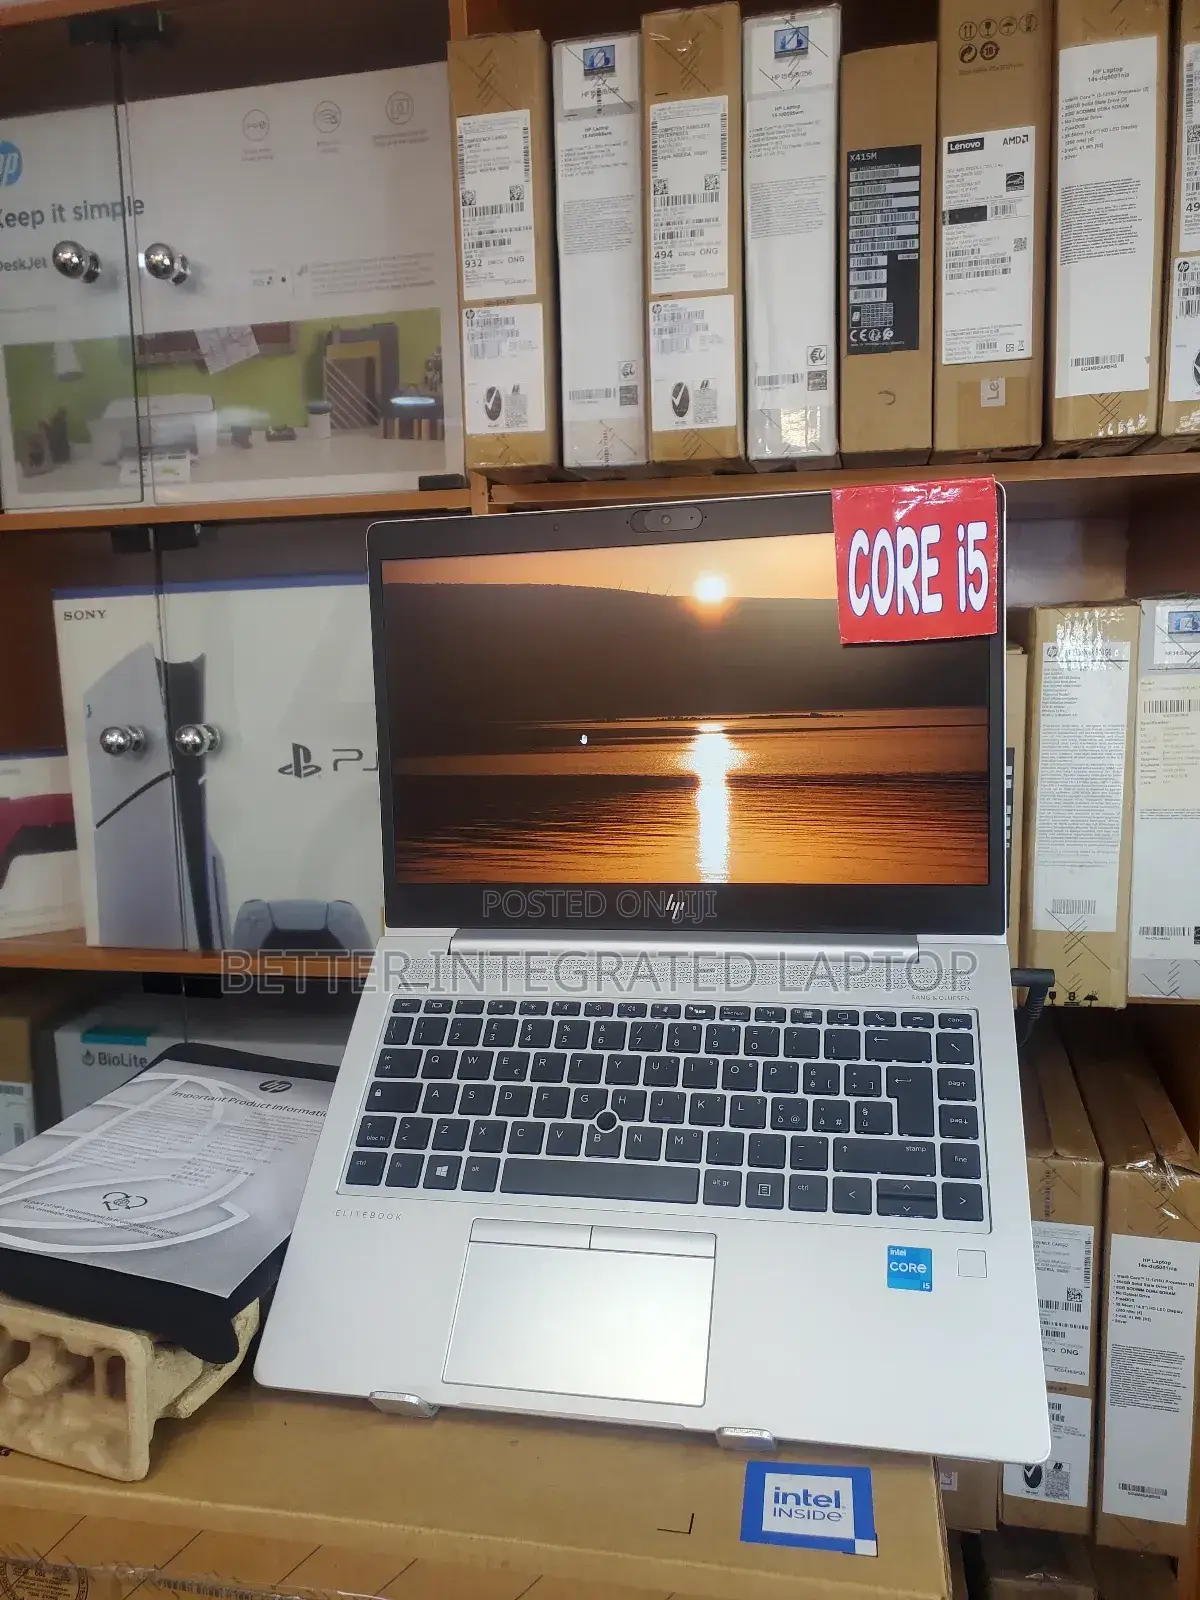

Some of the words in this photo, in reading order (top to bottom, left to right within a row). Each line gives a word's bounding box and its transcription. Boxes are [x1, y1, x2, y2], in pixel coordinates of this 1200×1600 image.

[950, 141, 981, 151] Lenovo
[1002, 135, 1022, 146] AMD
[850, 152, 877, 162] X415M
[51, 203, 67, 223] it
[72, 196, 145, 222] simple
[655, 249, 674, 260] 494
[700, 247, 719, 256] ONG
[465, 258, 483, 268] 932
[508, 255, 525, 264] ONG
[848, 527, 944, 617] CORE
[956, 520, 990, 613] i5
[63, 610, 107, 621] SONY
[674, 1039, 680, 1047] 8
[712, 1040, 719, 1048] 9
[97, 1051, 148, 1068] BioLite
[431, 1055, 440, 1064] Q
[467, 1056, 479, 1064] W
[502, 1057, 510, 1065] E
[538, 1058, 547, 1067] R
[576, 1059, 583, 1067] T
[614, 1060, 622, 1069] Y
[652, 1061, 660, 1070] U
[770, 1067, 778, 1076] P
[431, 1089, 440, 1098] A
[468, 1090, 475, 1099] S
[504, 1091, 513, 1100] D
[542, 1093, 549, 1101] F
[172, 1090, 226, 1102] Important
[227, 1097, 274, 1110] Product
[580, 1094, 589, 1103] G
[618, 1095, 627, 1105] H
[657, 1097, 664, 1106] J
[697, 1100, 705, 1109] K
[737, 1102, 745, 1111] L
[440, 1125, 449, 1134] Z
[478, 1126, 487, 1136] X
[516, 1128, 525, 1137] C
[556, 1130, 564, 1139] V
[593, 1133, 602, 1143] B
[633, 1133, 643, 1143] N
[674, 1136, 684, 1145] M
[954, 1155, 967, 1163] fine
[335, 1208, 403, 1221] ELITEBOOK
[890, 1248, 907, 1257] intel
[1152, 1258, 1172, 1266] Laptop
[922, 1281, 931, 1290] i5
[1060, 1347, 1079, 1356] ONG
[773, 1486, 841, 1510] intel
